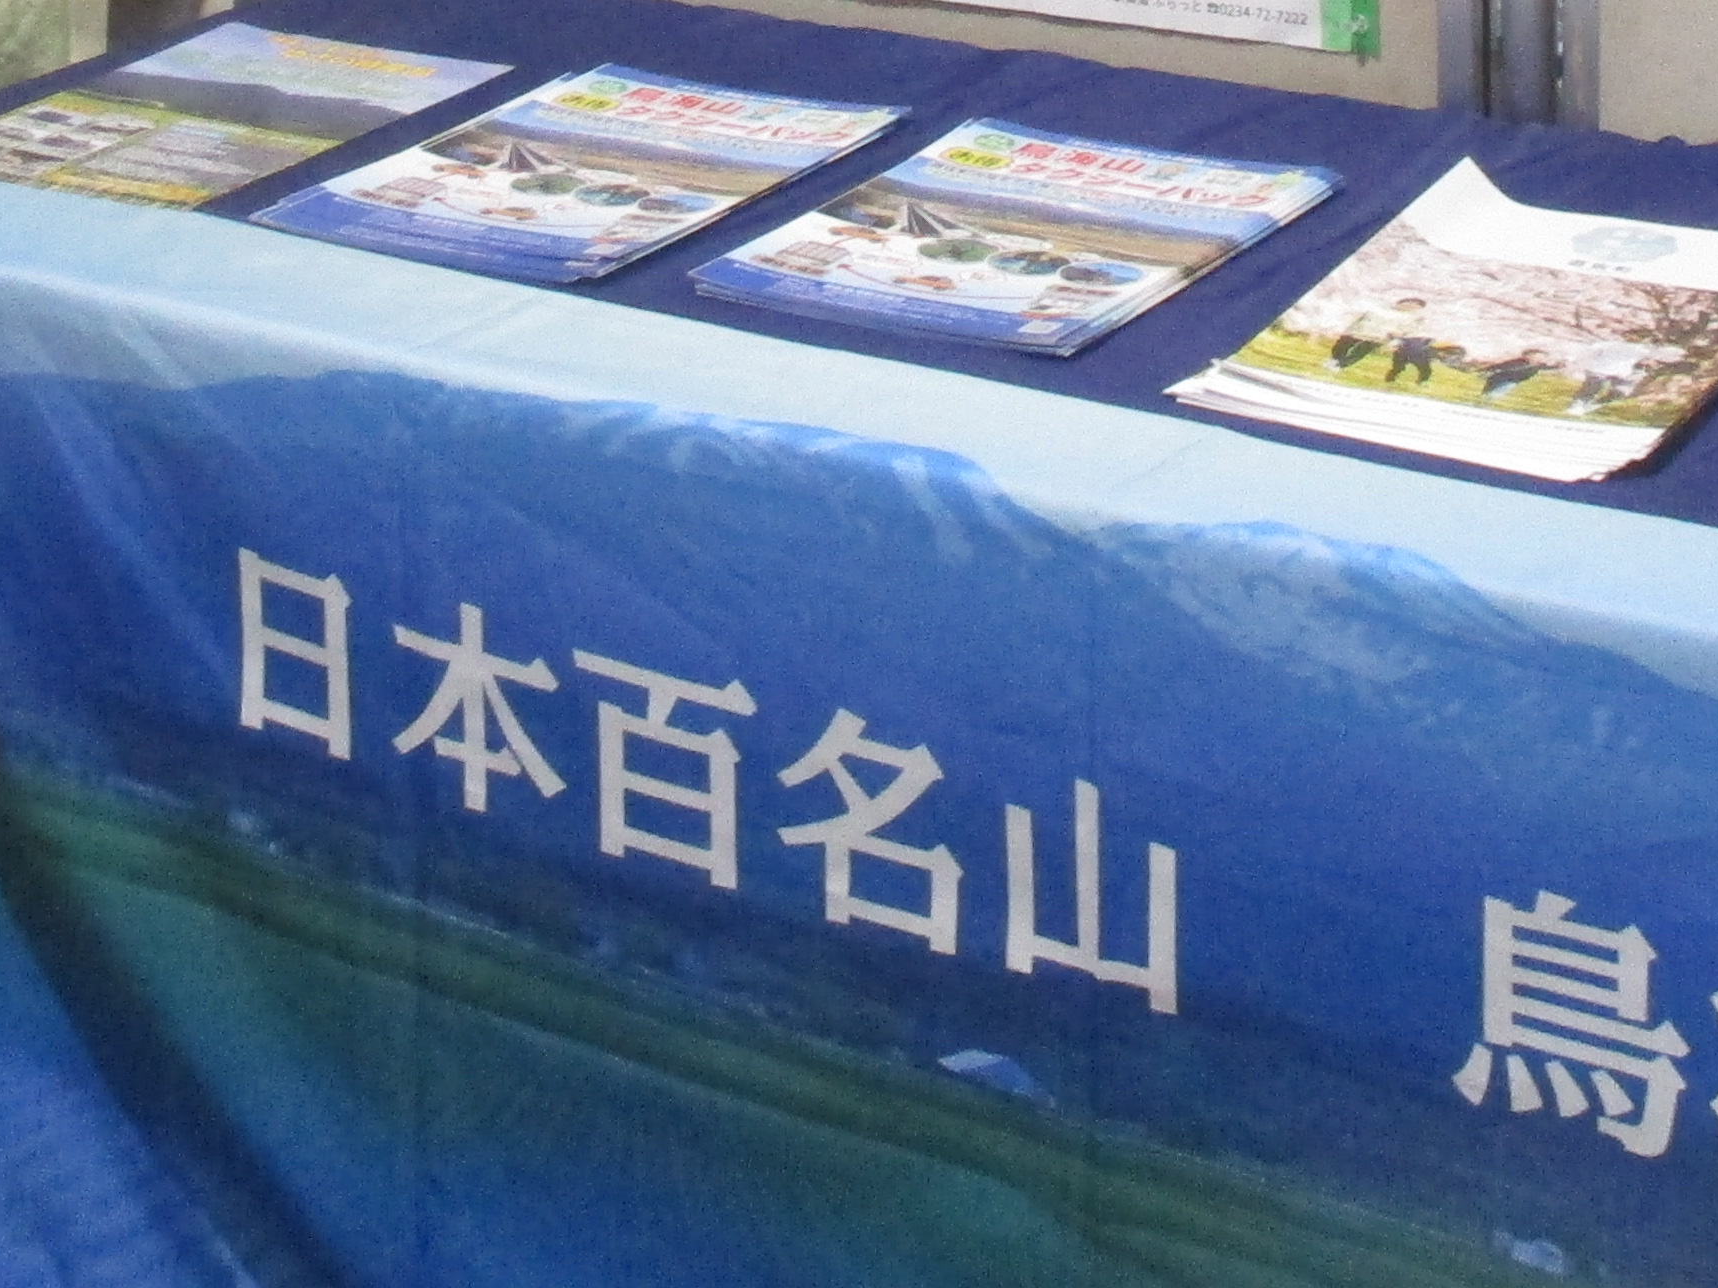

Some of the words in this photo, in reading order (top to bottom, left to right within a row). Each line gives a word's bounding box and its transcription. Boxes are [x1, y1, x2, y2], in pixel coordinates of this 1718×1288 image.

[236, 546, 1178, 1015] 日本百名山
